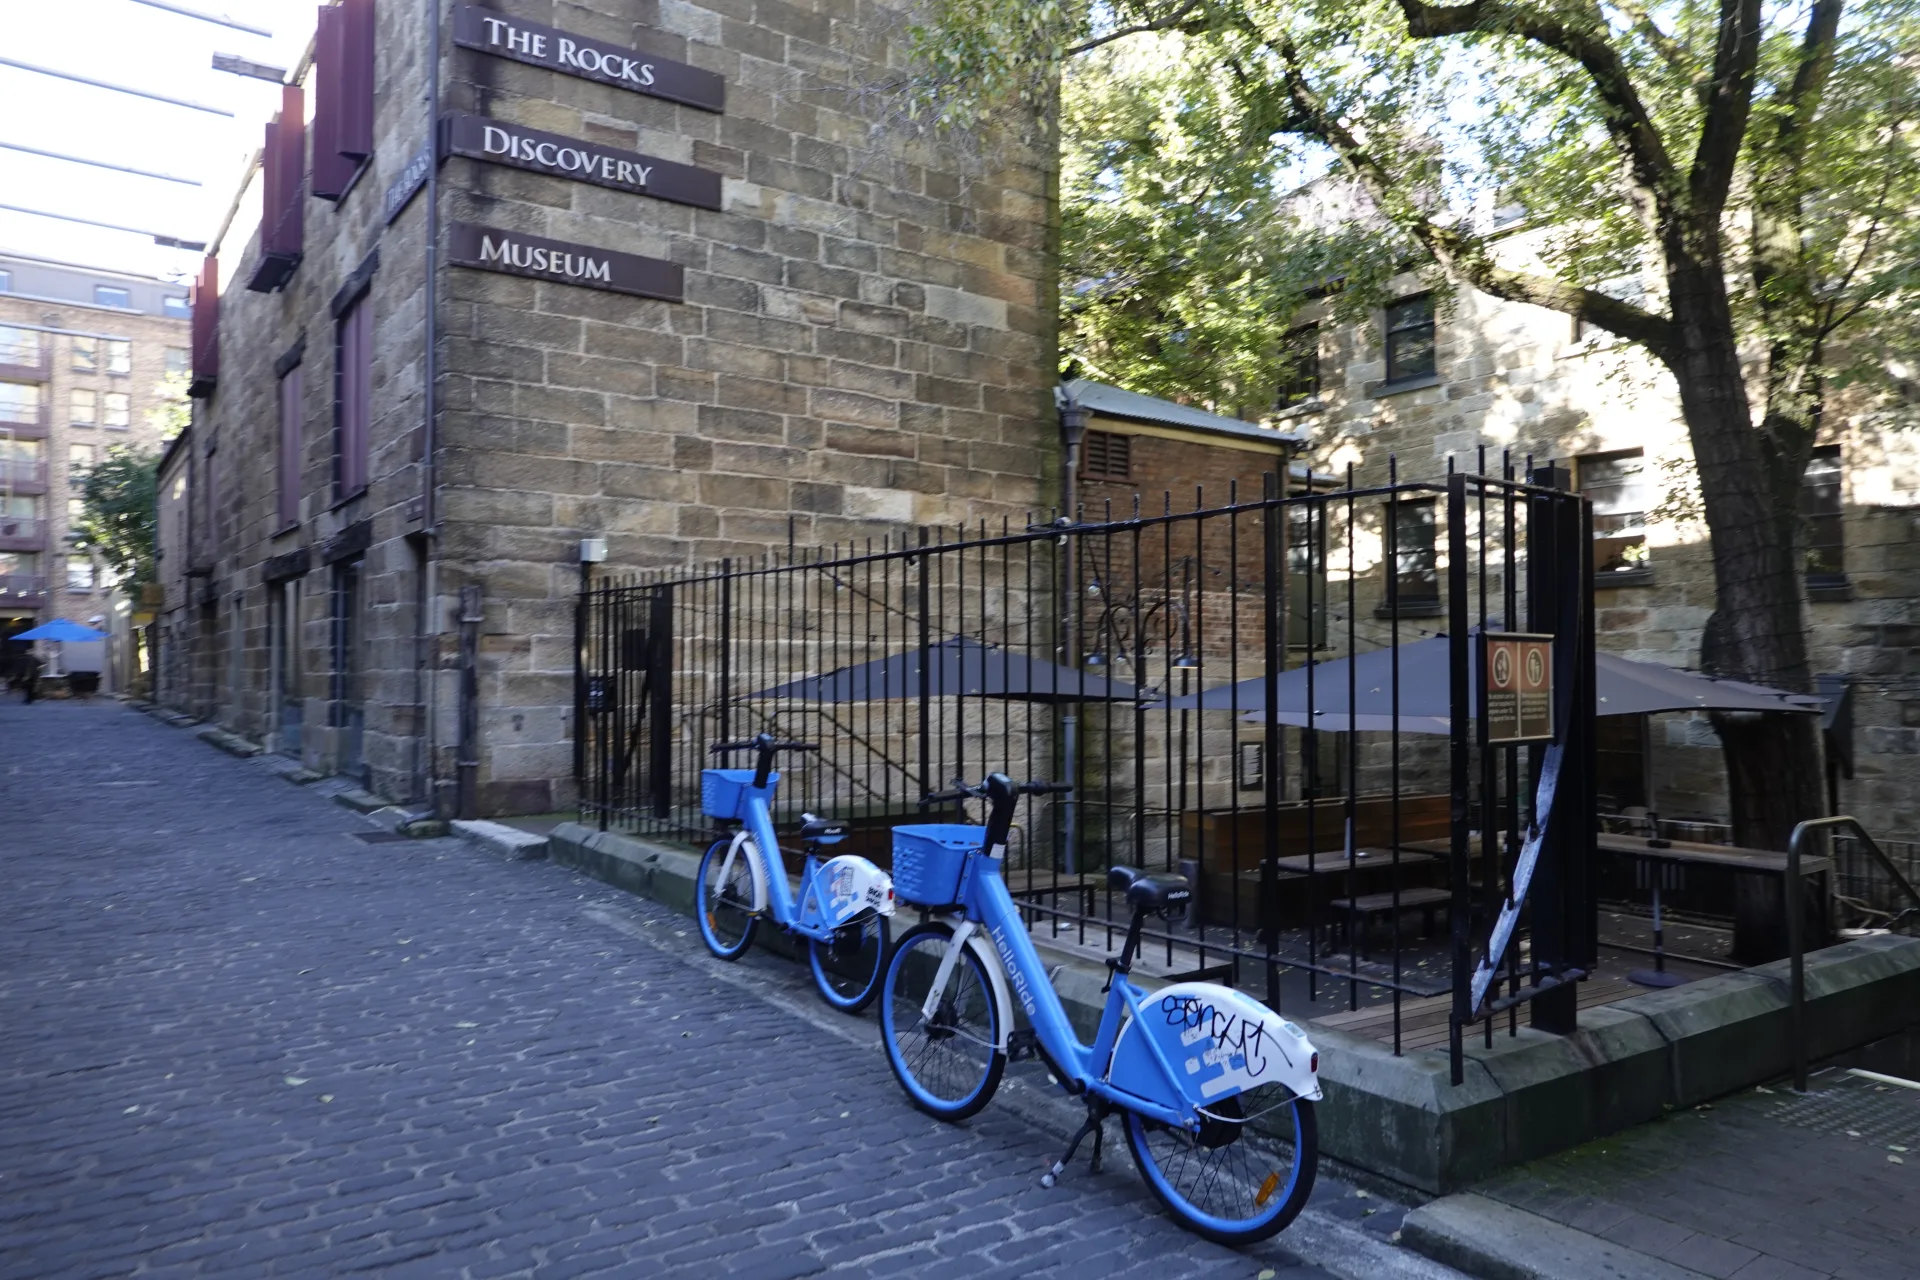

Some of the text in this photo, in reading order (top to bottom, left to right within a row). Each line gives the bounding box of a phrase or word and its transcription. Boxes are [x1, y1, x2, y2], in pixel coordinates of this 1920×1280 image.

[483, 17, 655, 86] THE ROCKS
[482, 126, 653, 186] DISCOVERY
[479, 234, 612, 283] MUSEUM
[991, 925, 1036, 1017] HelloRide
